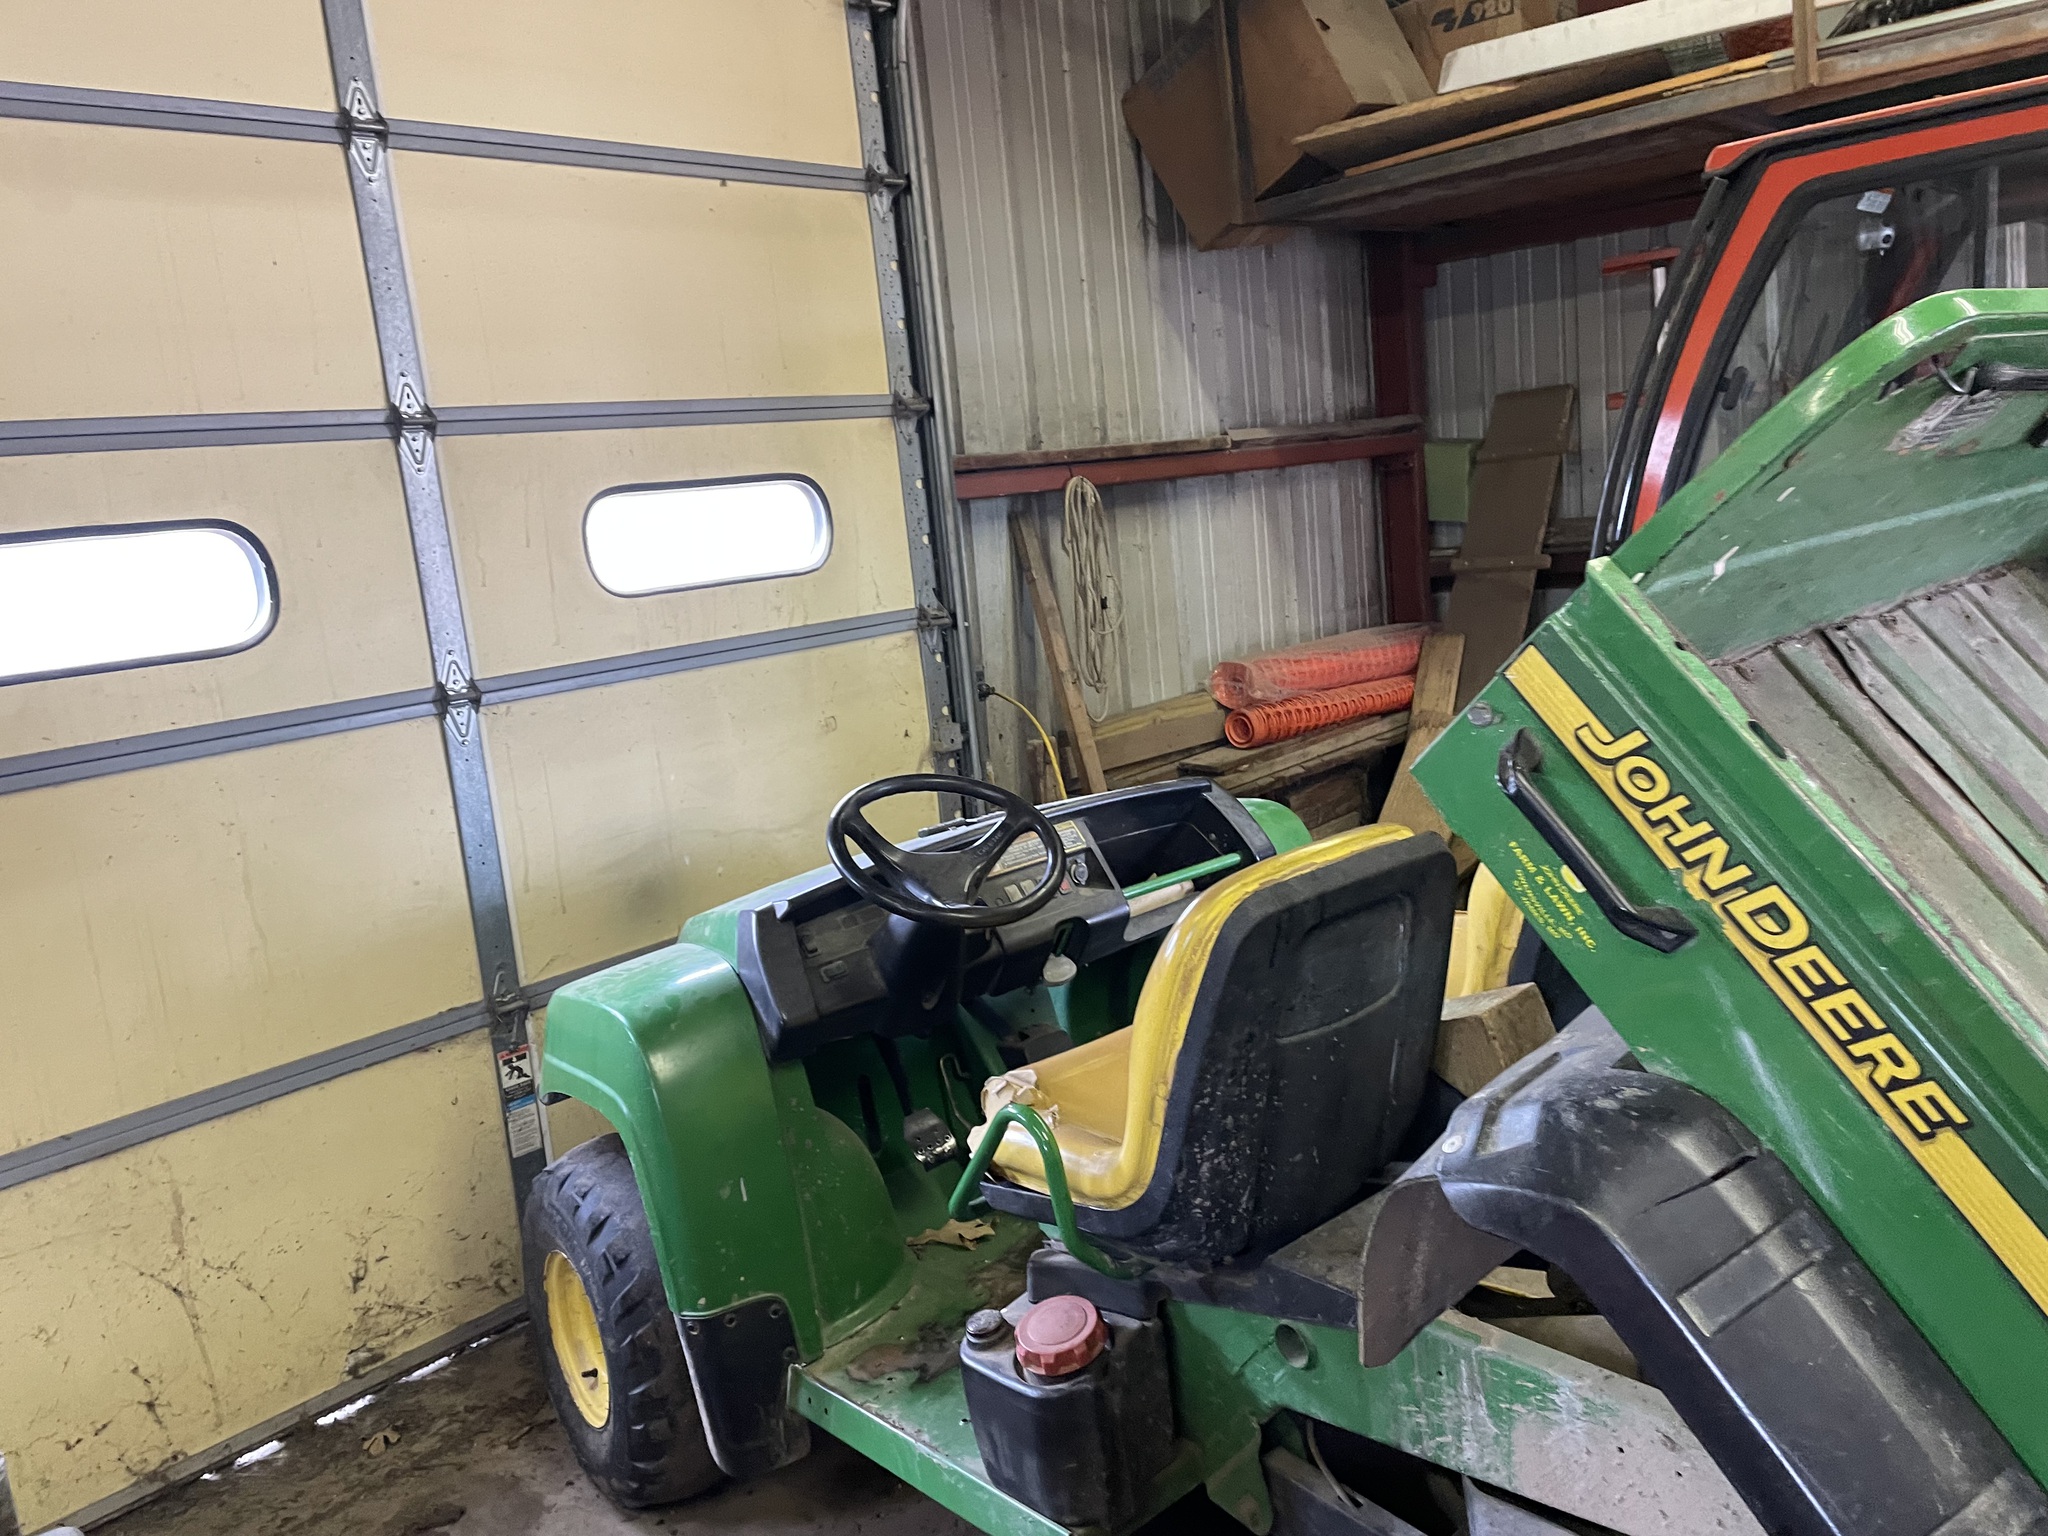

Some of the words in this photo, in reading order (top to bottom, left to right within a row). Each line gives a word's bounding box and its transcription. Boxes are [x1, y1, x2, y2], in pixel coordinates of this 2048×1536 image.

[1508, 841, 1537, 873] FARM
[1534, 875, 1546, 885] &
[1575, 722, 1752, 902] JOHN
[1725, 883, 1971, 1140] DEERE
